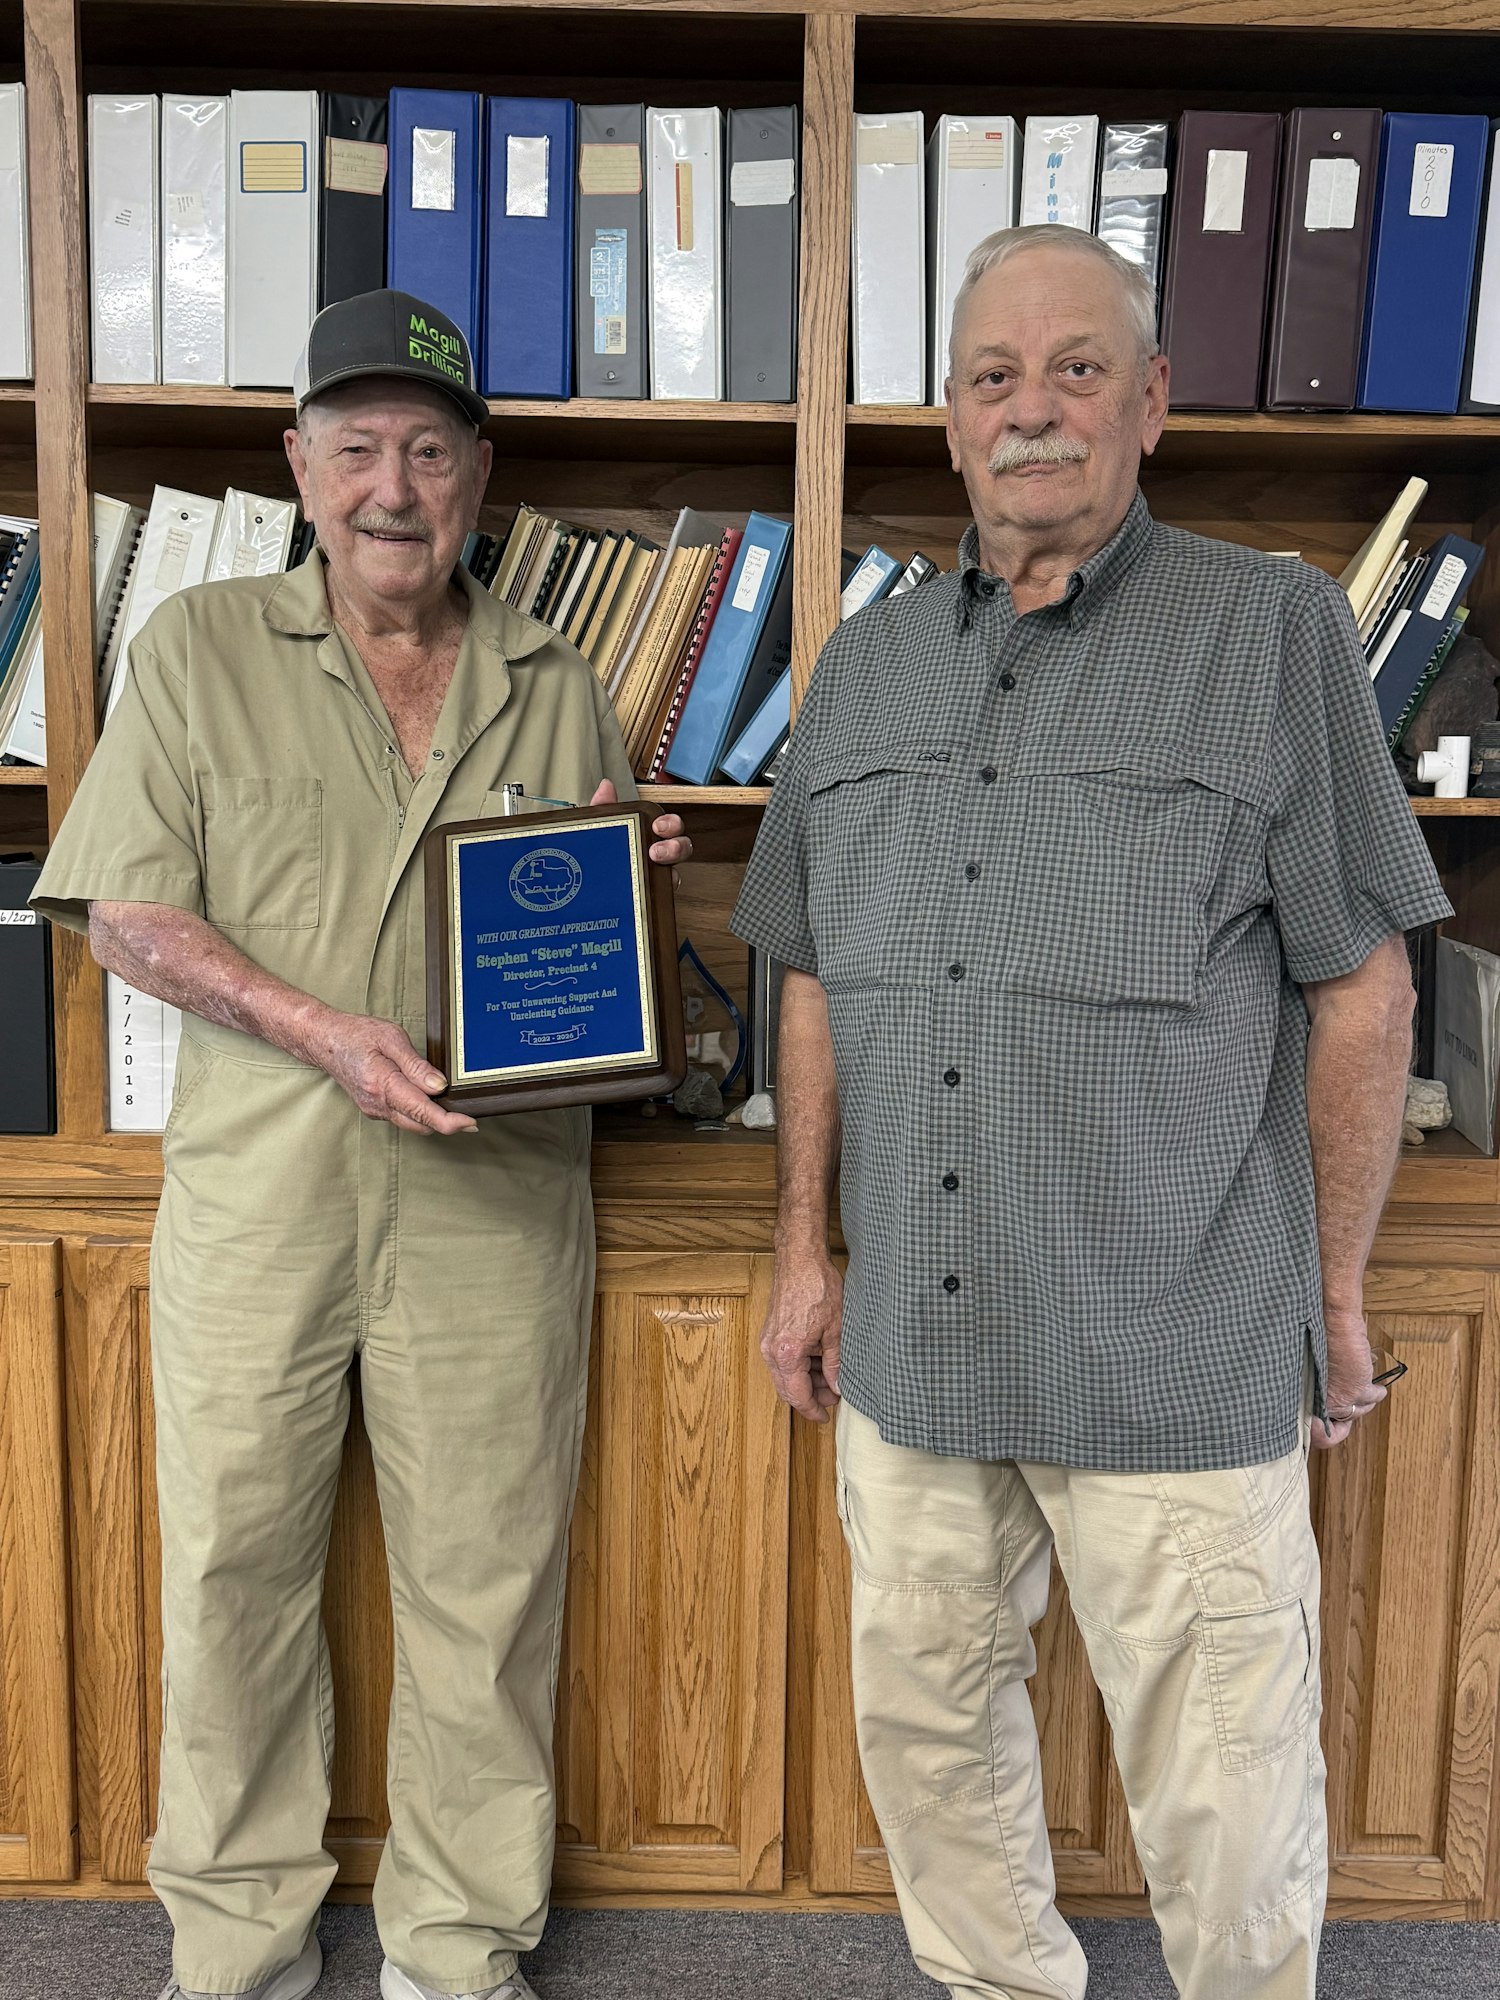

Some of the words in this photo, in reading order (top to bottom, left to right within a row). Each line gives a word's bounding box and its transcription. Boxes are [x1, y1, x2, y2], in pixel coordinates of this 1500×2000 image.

[1417, 145, 1448, 154] Minutes
[410, 313, 461, 355] Magill
[409, 340, 465, 385] Drilling
[476, 932, 499, 945] WITH
[499, 930, 518, 942] OUR
[518, 924, 560, 939] GREATEST
[559, 918, 620, 935] APPRECIATION
[476, 952, 529, 969] Stephen
[581, 939, 622, 957] Magill
[503, 968, 546, 982] Director,
[547, 962, 589, 976] Precinct
[590, 961, 598, 971] 4
[486, 1002, 500, 1012] For
[501, 1000, 521, 1010] Your
[522, 994, 567, 1007] Unwavering
[568, 990, 600, 1002] Support
[601, 987, 618, 998] And
[510, 1008, 557, 1021] Unrelenting
[558, 1004, 595, 1016] Guidance
[532, 1035, 551, 1043] 2022
